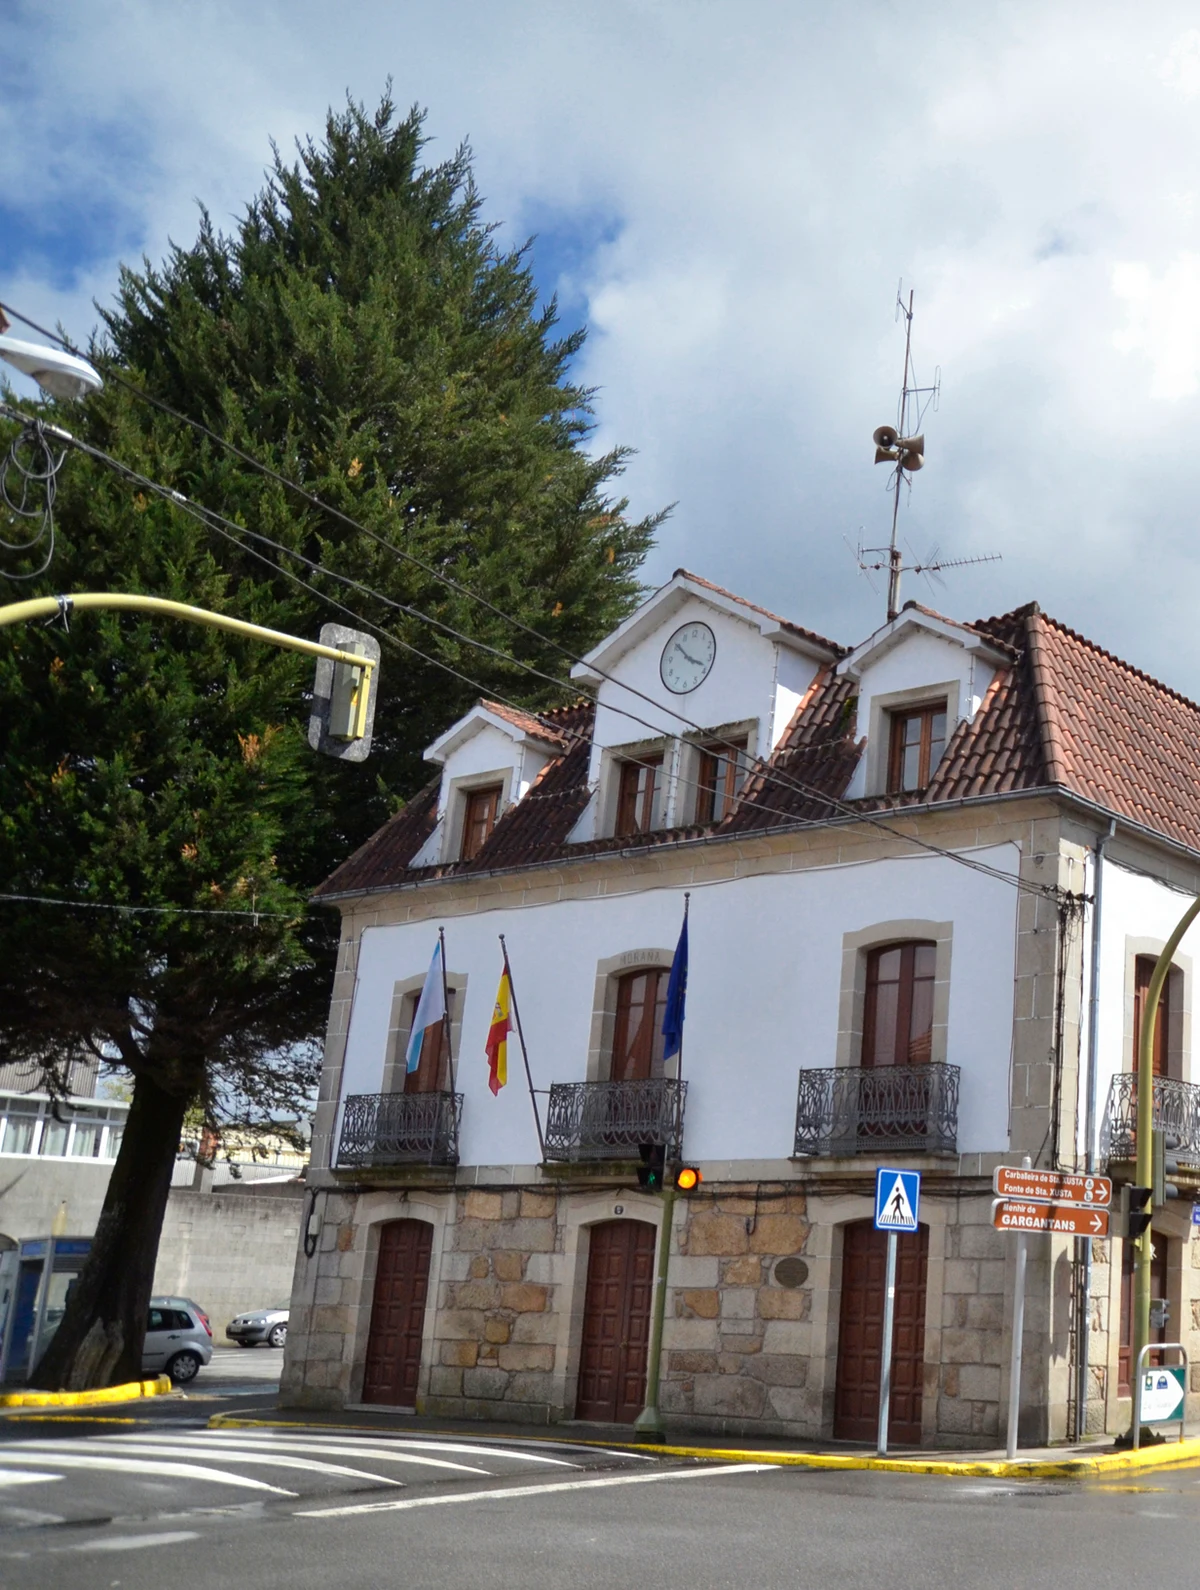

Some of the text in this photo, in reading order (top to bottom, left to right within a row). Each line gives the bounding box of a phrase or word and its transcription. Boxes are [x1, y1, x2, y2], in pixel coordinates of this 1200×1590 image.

[692, 629, 698, 638] 12
[707, 640, 712, 649] 2
[668, 656, 673, 664] 9
[707, 653, 712, 662] 3
[668, 668, 674, 676] 8
[674, 676, 680, 685] 7
[682, 680, 688, 688] 6
[693, 676, 698, 684] 5
[1004, 1170, 1039, 1182] Carballeira
[1062, 1177, 1083, 1186] XUSTA
[1004, 1184, 1072, 1198] Fonte de Sta. XUSTA
[1003, 1203, 1036, 1214] Menhir de
[1001, 1214, 1076, 1231] GARGANTANS
